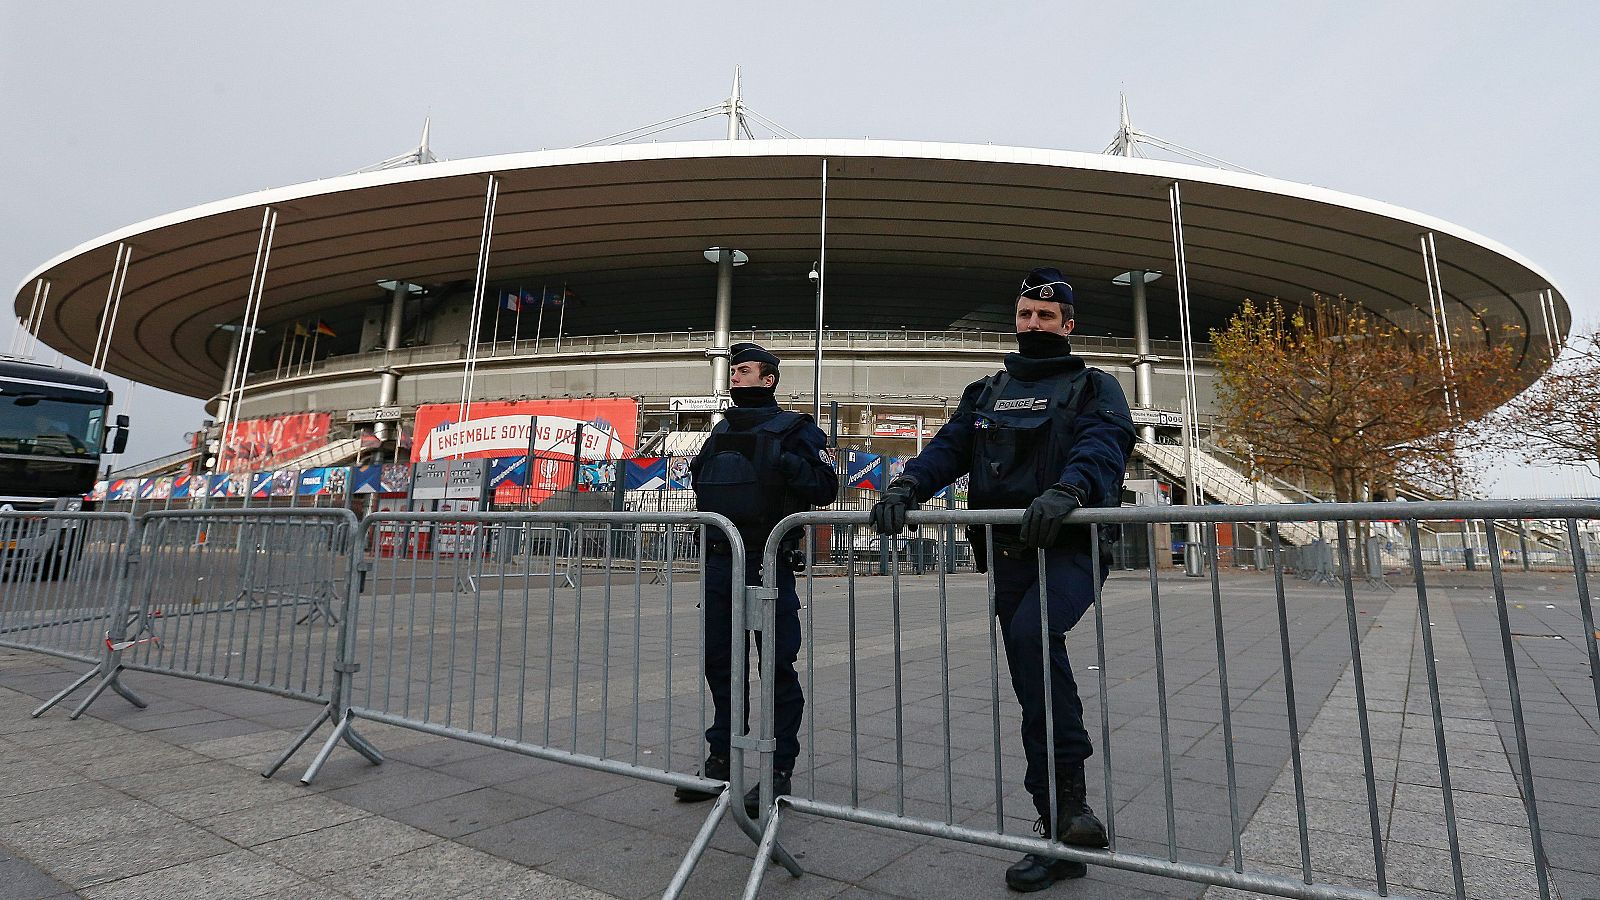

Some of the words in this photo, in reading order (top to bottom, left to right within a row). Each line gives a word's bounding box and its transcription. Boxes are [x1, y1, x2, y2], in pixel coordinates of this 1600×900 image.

[720, 400, 729, 410] A
[999, 400, 1030, 408] POLICE
[438, 426, 497, 450] ENSEMBLE
[501, 424, 551, 440] SOYONS
